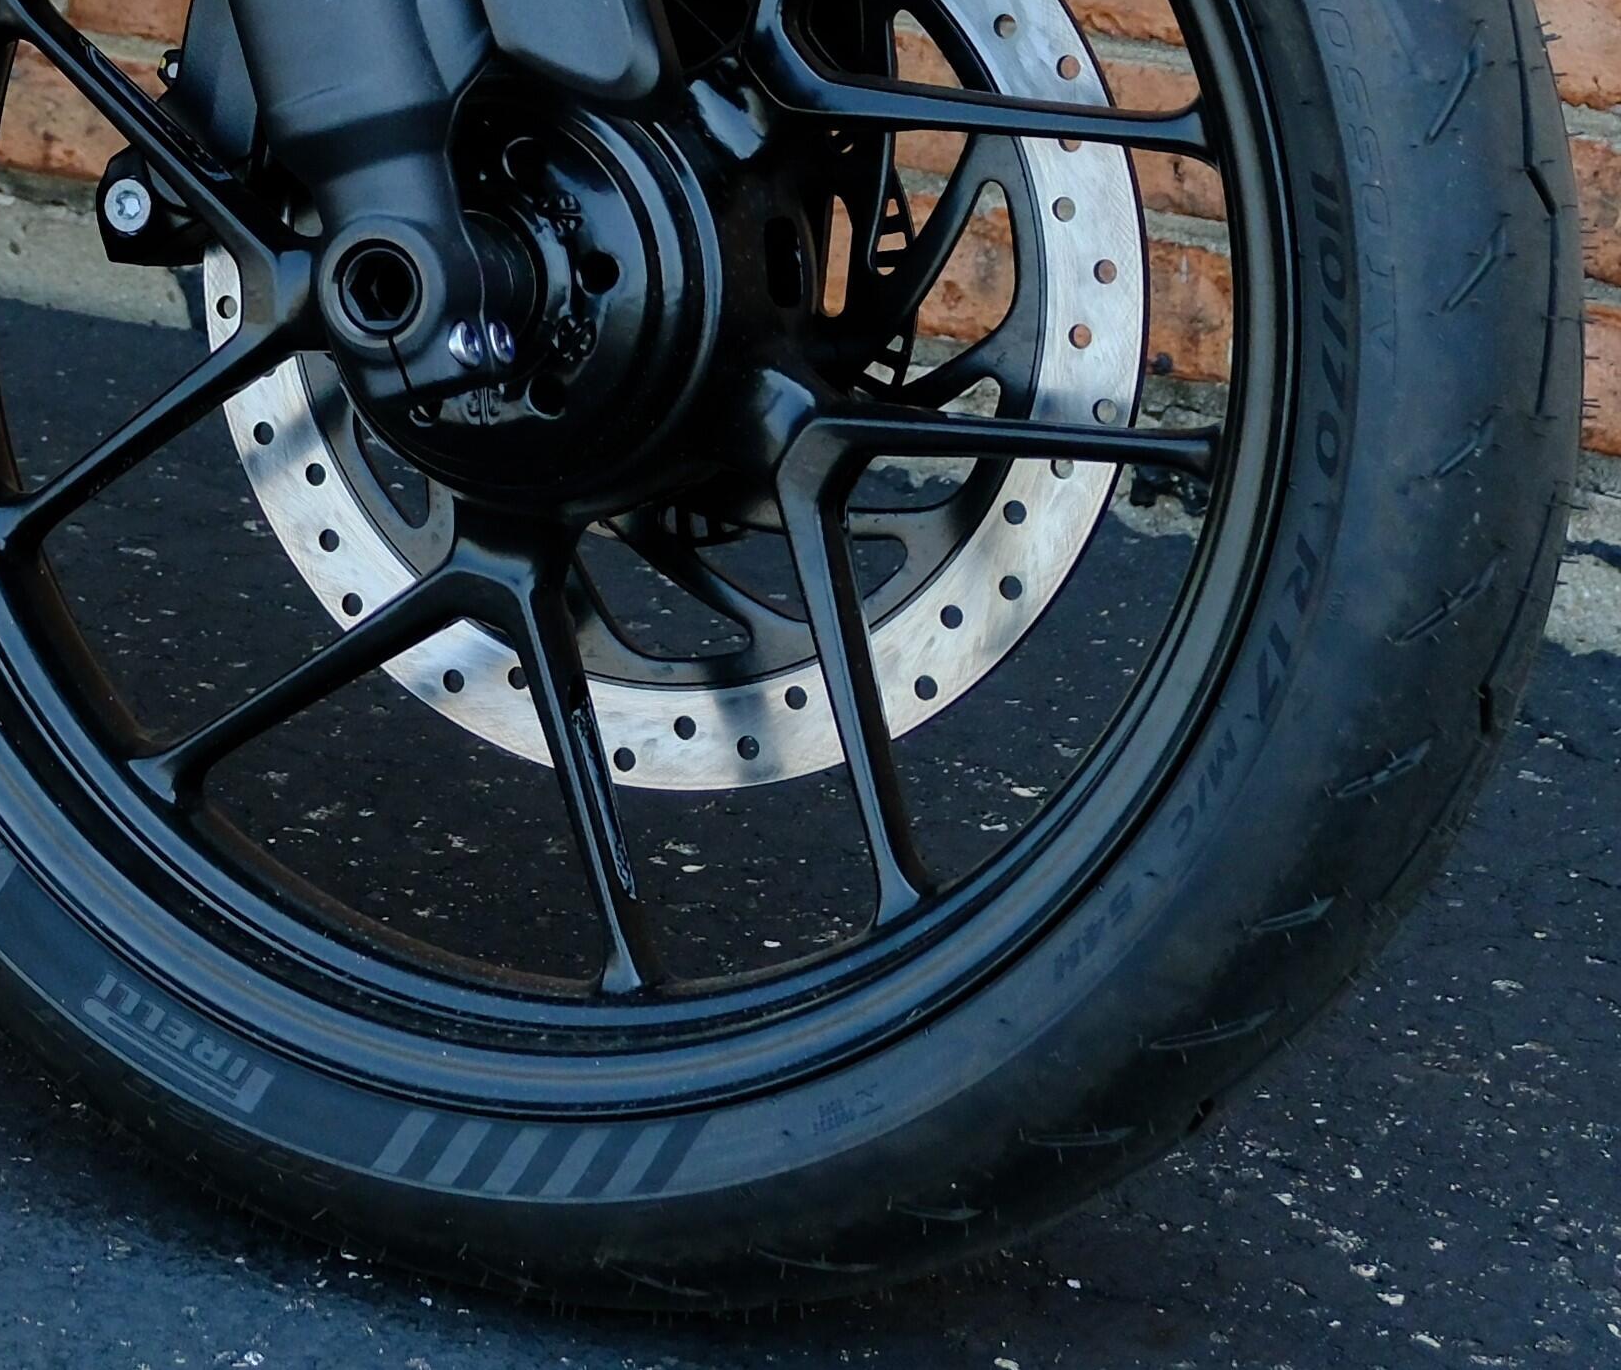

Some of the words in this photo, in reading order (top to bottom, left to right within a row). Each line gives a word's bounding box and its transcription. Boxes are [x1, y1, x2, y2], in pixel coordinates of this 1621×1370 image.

[1311, 170, 1351, 481] 110/70
[1290, 531, 1332, 607] R
[1256, 618, 1295, 725] 17
[1169, 727, 1239, 849] M/C
[81, 971, 275, 1114] PIRELLI
